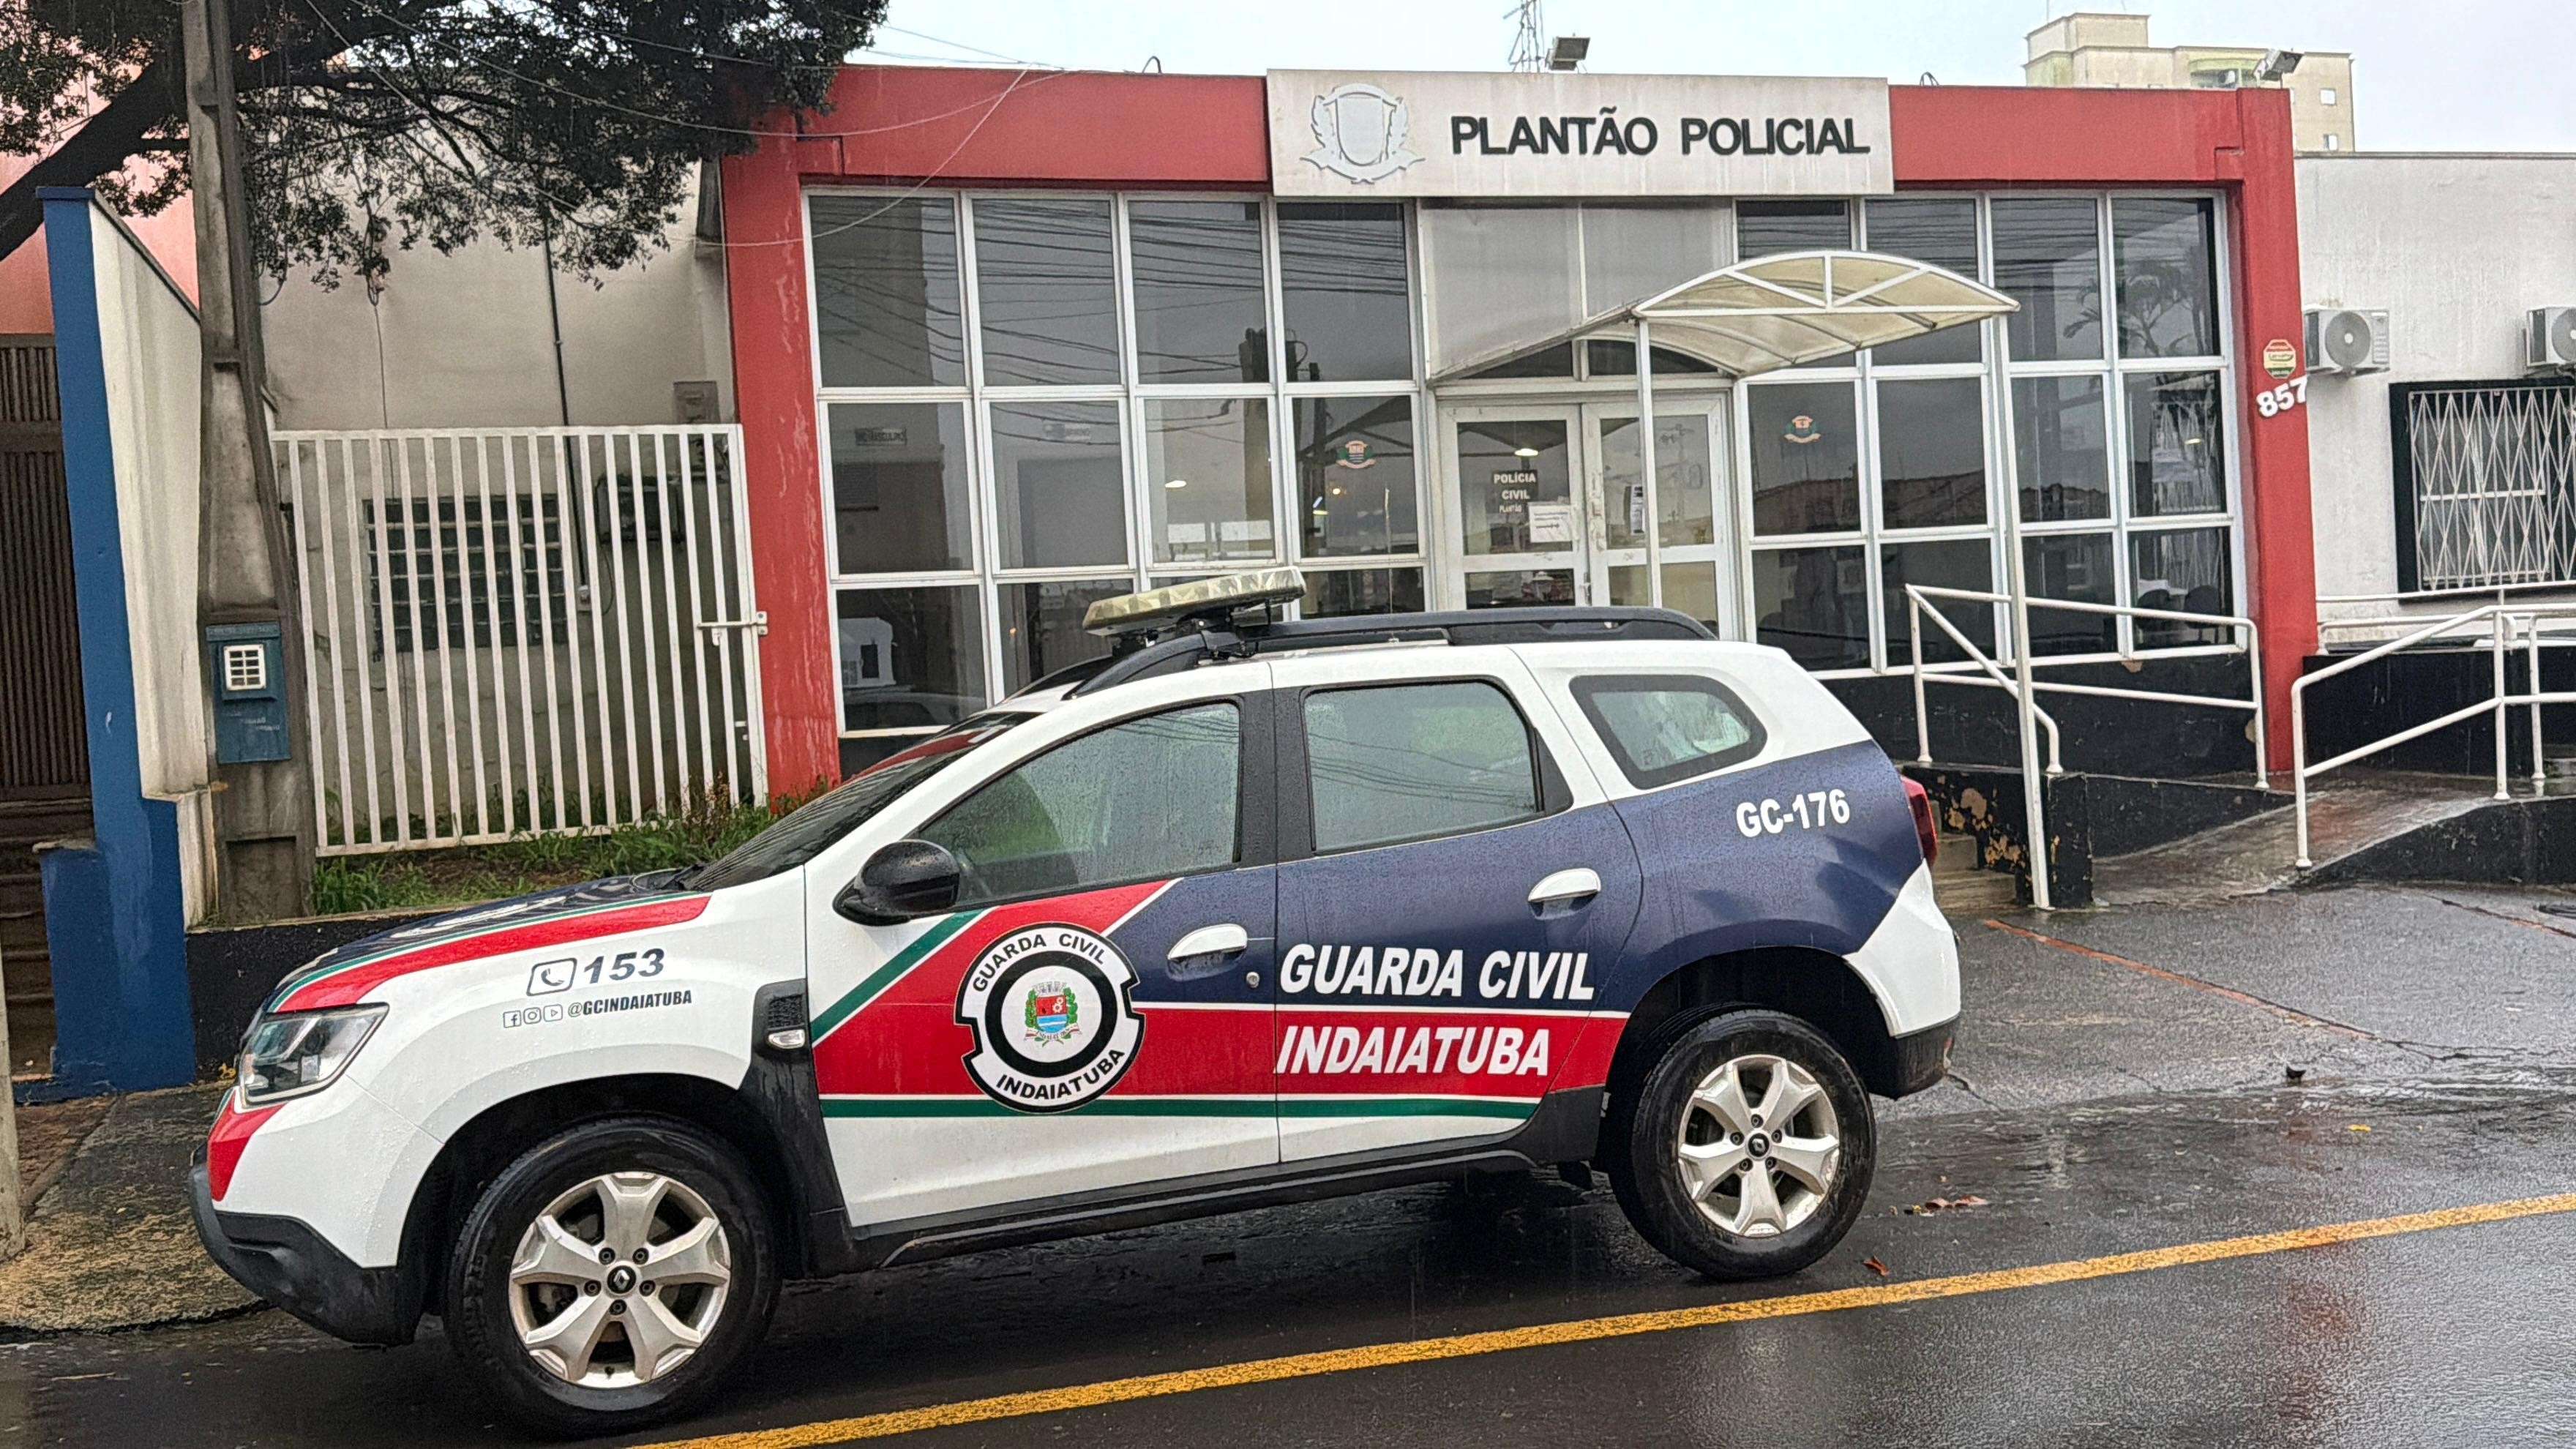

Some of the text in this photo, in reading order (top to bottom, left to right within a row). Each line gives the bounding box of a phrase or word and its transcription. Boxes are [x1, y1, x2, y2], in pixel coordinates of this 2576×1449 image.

[1450, 106, 1871, 156] PLANTÃO POLICIAL
[2256, 374, 2307, 417] 857
[1494, 471, 1536, 484] POLÍCIA
[1502, 490, 1530, 500] CIVIL
[1736, 789, 1850, 837] GC-176
[584, 948, 664, 984] 153
[973, 933, 1105, 992] GUARDA CIVIL
[1279, 943, 1595, 1000] GUARDA CIVIL
[568, 990, 692, 1017] @GCINDAIATUBA
[995, 1049, 1125, 1100] INDAIATUBA
[1273, 1025, 1550, 1077] INDAIATUBA
